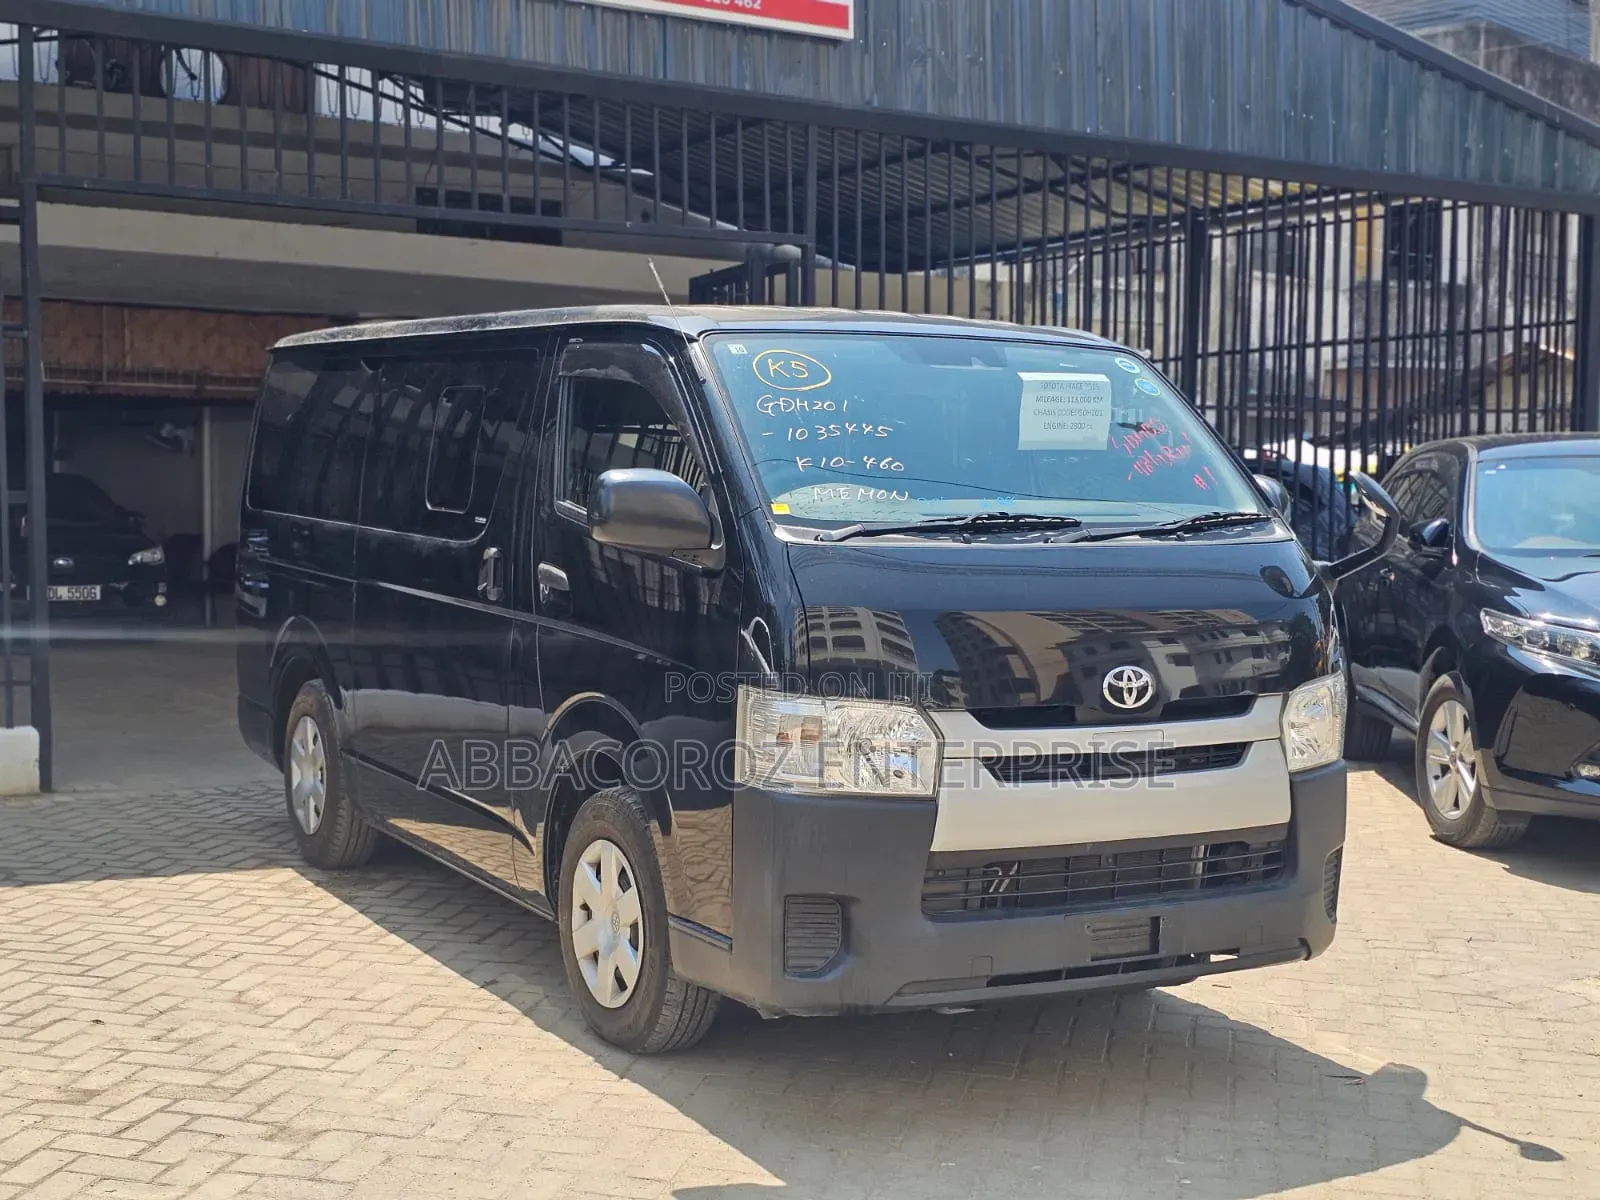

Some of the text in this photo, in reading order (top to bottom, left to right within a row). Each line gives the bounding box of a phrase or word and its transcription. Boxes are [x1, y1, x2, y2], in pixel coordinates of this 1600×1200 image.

[767, 357, 809, 379] K5
[757, 395, 848, 416] GDH201
[814, 487, 909, 501] MEMON
